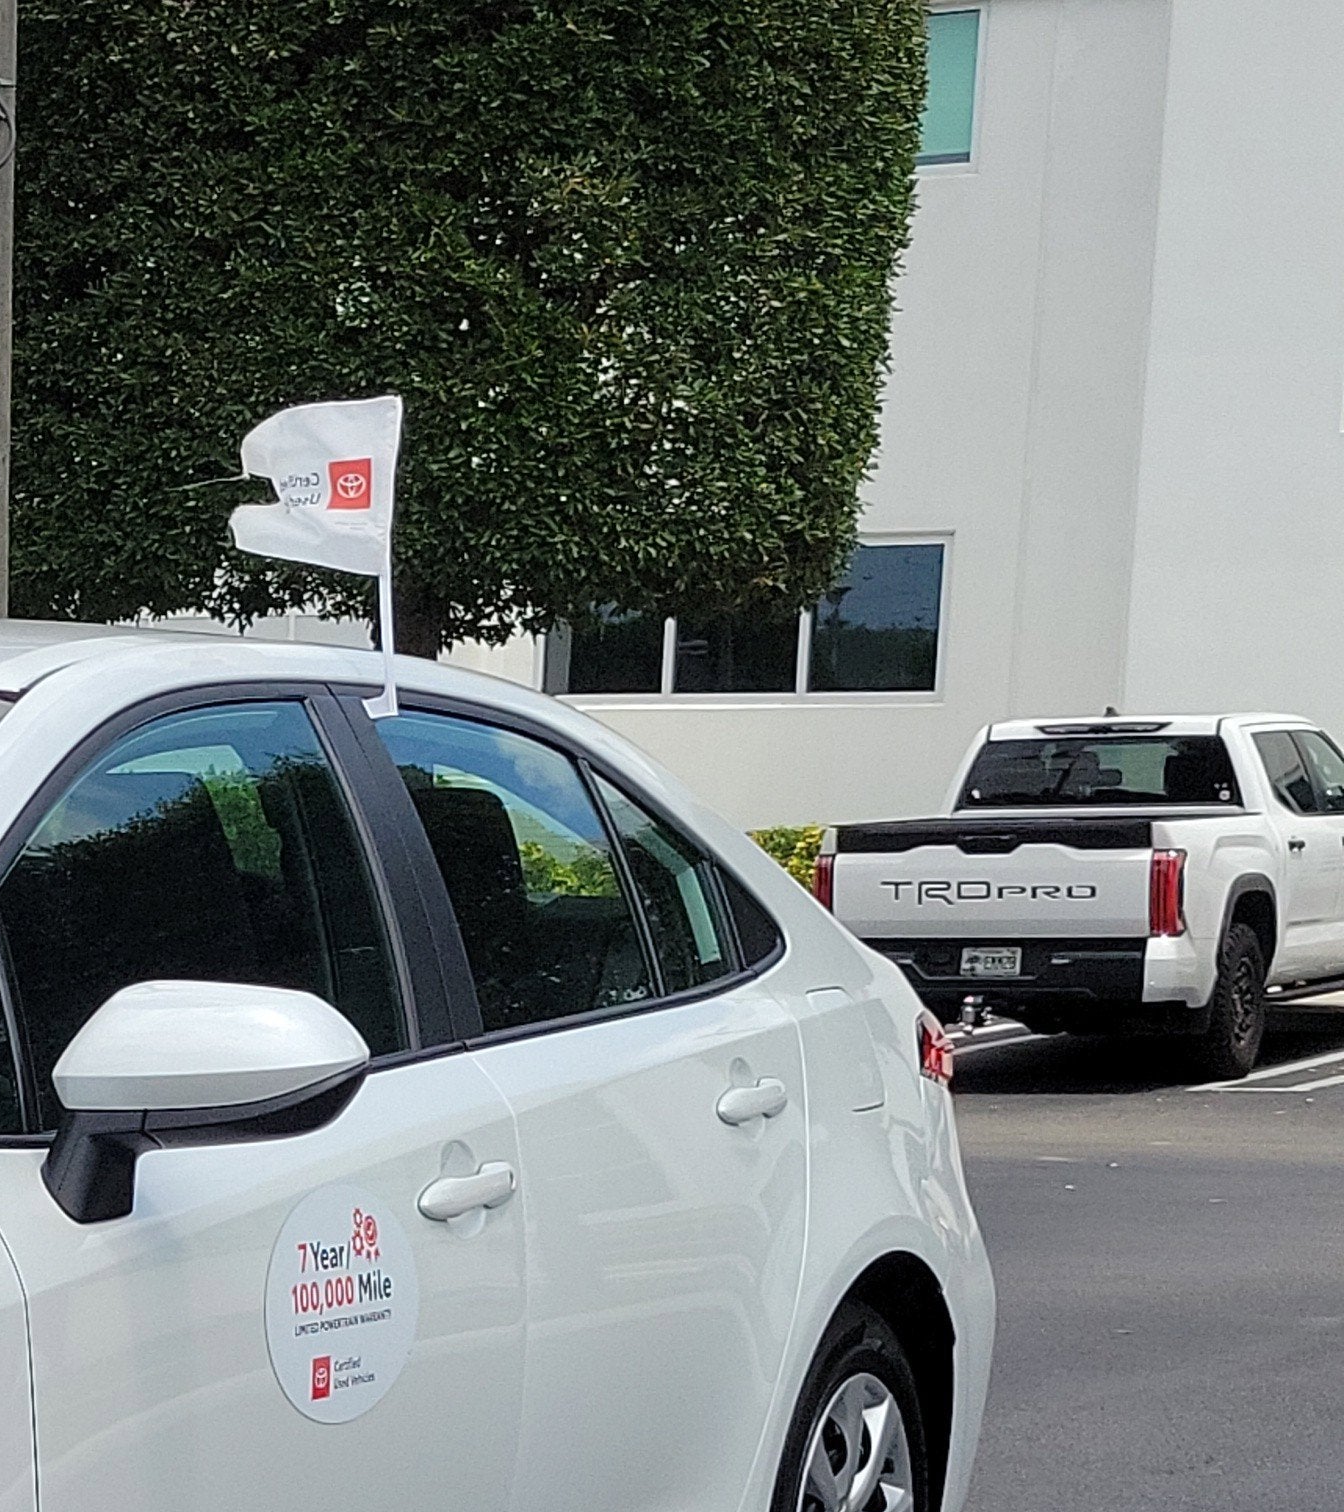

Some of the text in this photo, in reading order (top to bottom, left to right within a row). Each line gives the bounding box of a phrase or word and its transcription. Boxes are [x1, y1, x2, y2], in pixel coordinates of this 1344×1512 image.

[880, 880, 1097, 906] TRD PRO
[297, 1243, 308, 1273] 7
[291, 1269, 392, 1315] 100,000 Mile
